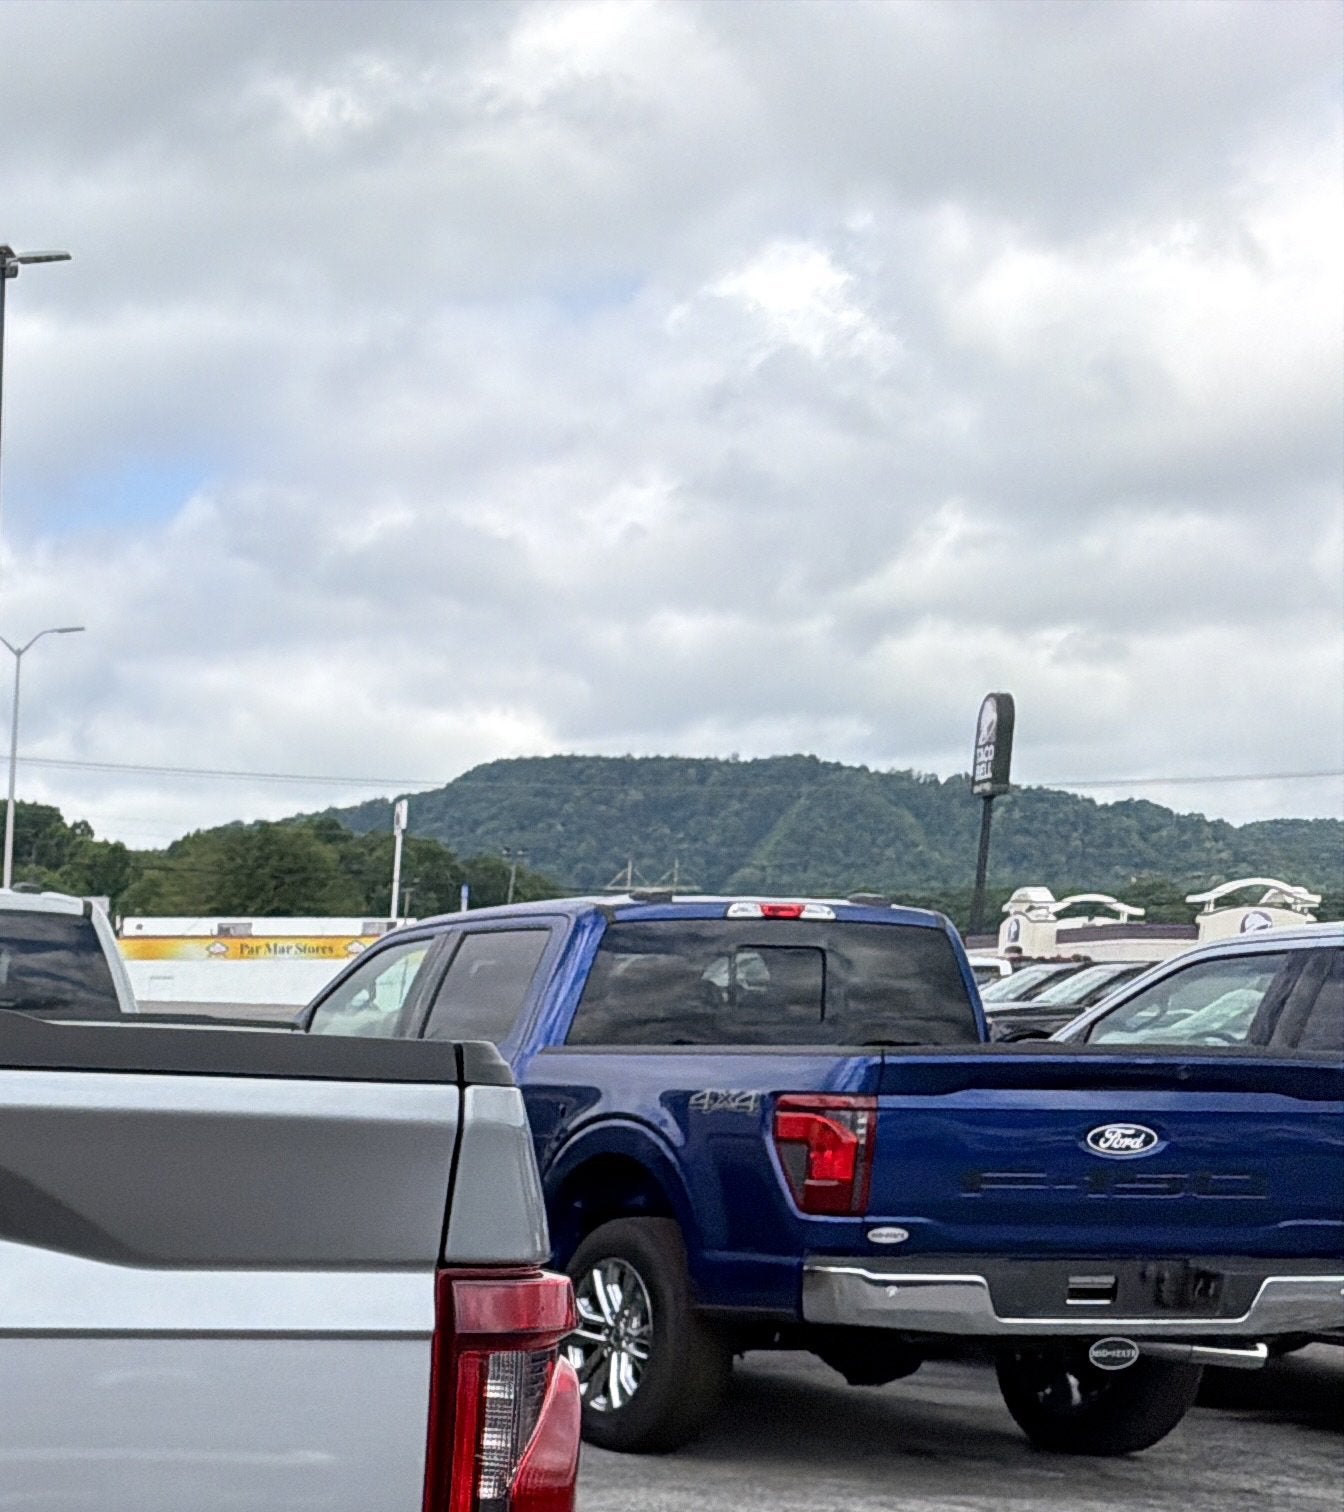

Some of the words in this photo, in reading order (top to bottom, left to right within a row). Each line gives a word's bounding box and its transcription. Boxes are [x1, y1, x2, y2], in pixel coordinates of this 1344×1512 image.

[238, 943, 262, 955] Par
[297, 943, 334, 955] Stores
[1098, 1127, 1144, 1150] Ford
